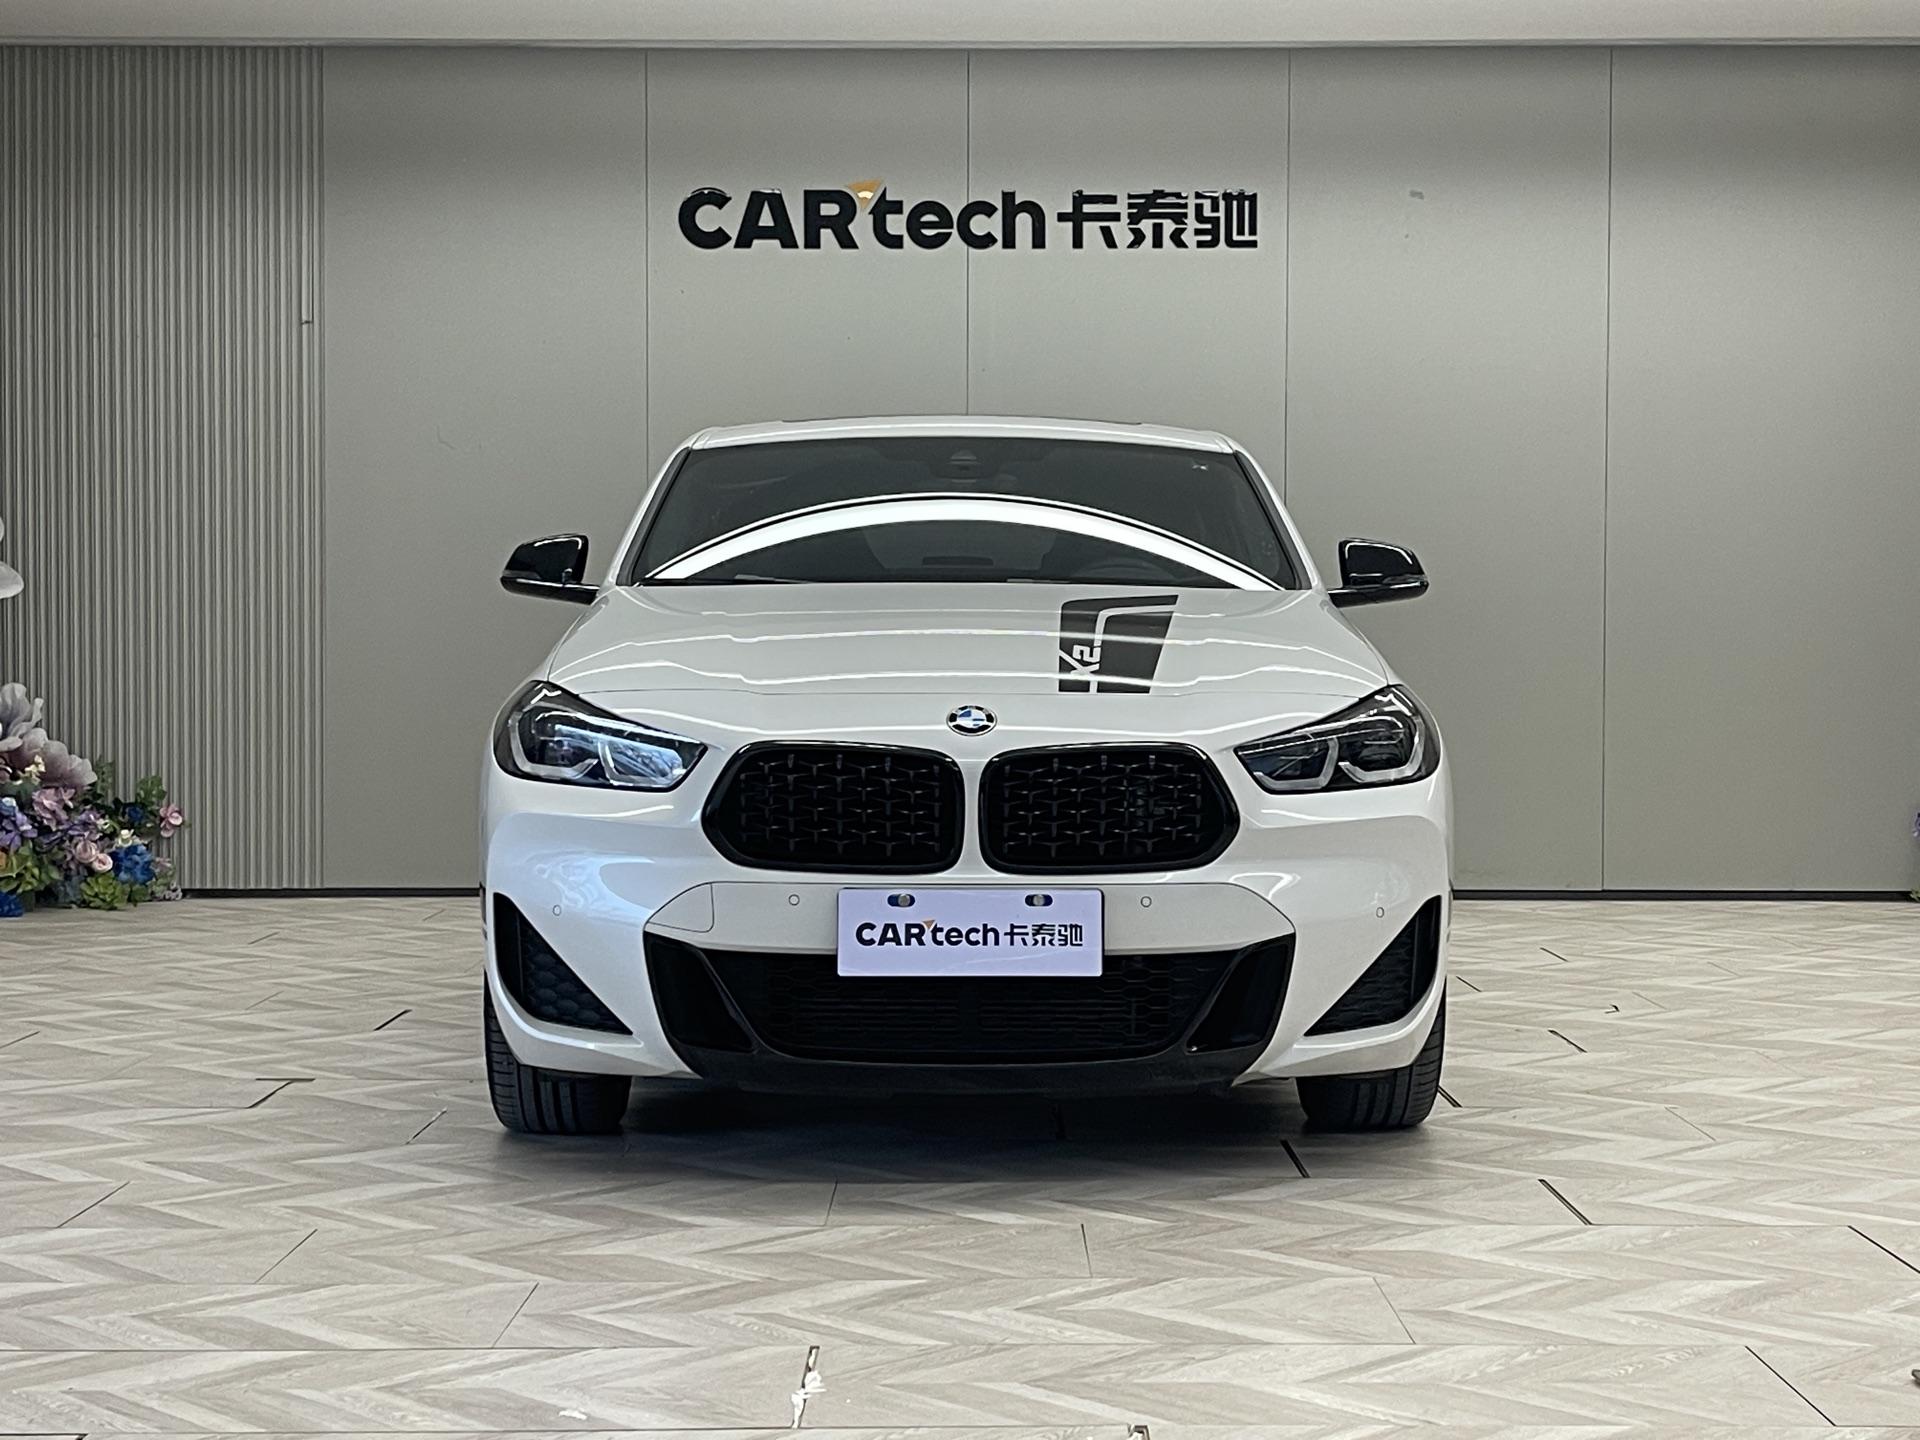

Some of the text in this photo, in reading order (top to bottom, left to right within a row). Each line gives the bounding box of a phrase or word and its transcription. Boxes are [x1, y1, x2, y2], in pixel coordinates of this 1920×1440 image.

[678, 186, 1259, 250] CARtech 卡泰驰
[855, 920, 1083, 946] CARtech 卡泰驰
